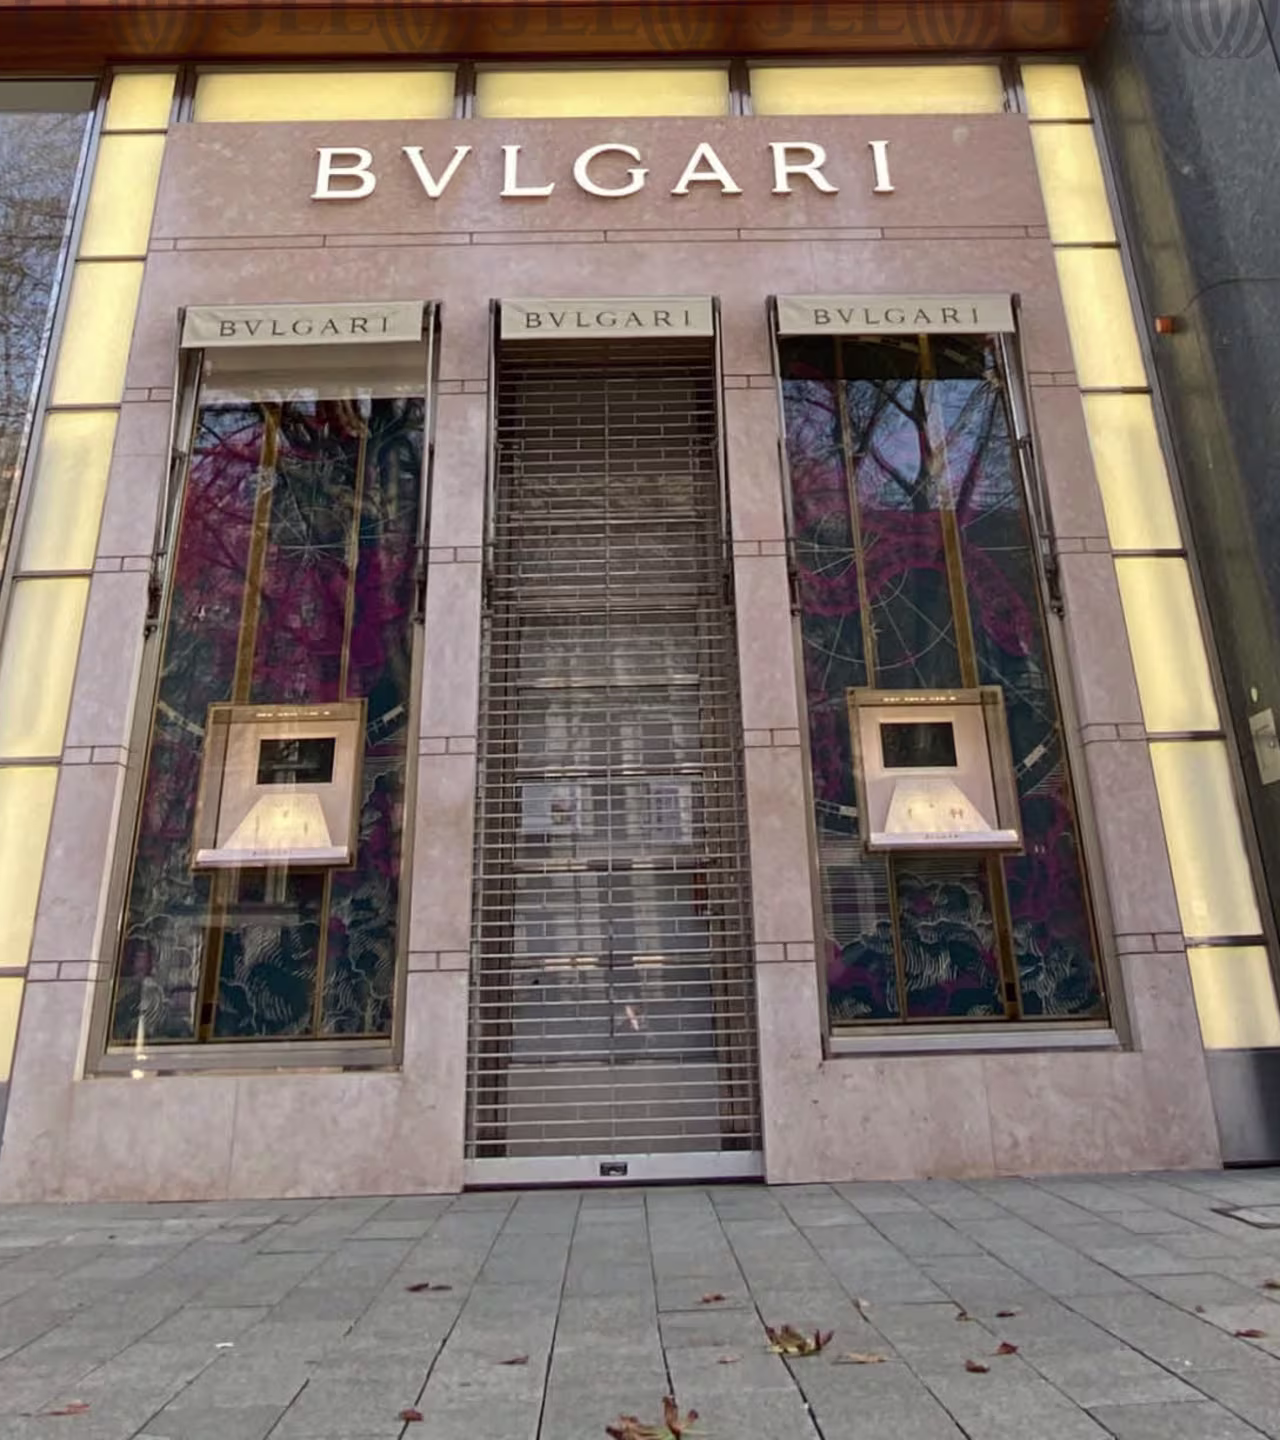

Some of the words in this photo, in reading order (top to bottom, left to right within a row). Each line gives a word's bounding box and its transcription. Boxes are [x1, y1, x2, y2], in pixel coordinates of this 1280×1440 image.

[310, 140, 895, 199] BVLGARI
[525, 309, 691, 329] BVLGARI
[814, 306, 979, 325] BVLGARI
[220, 317, 390, 337] BVLGARI
